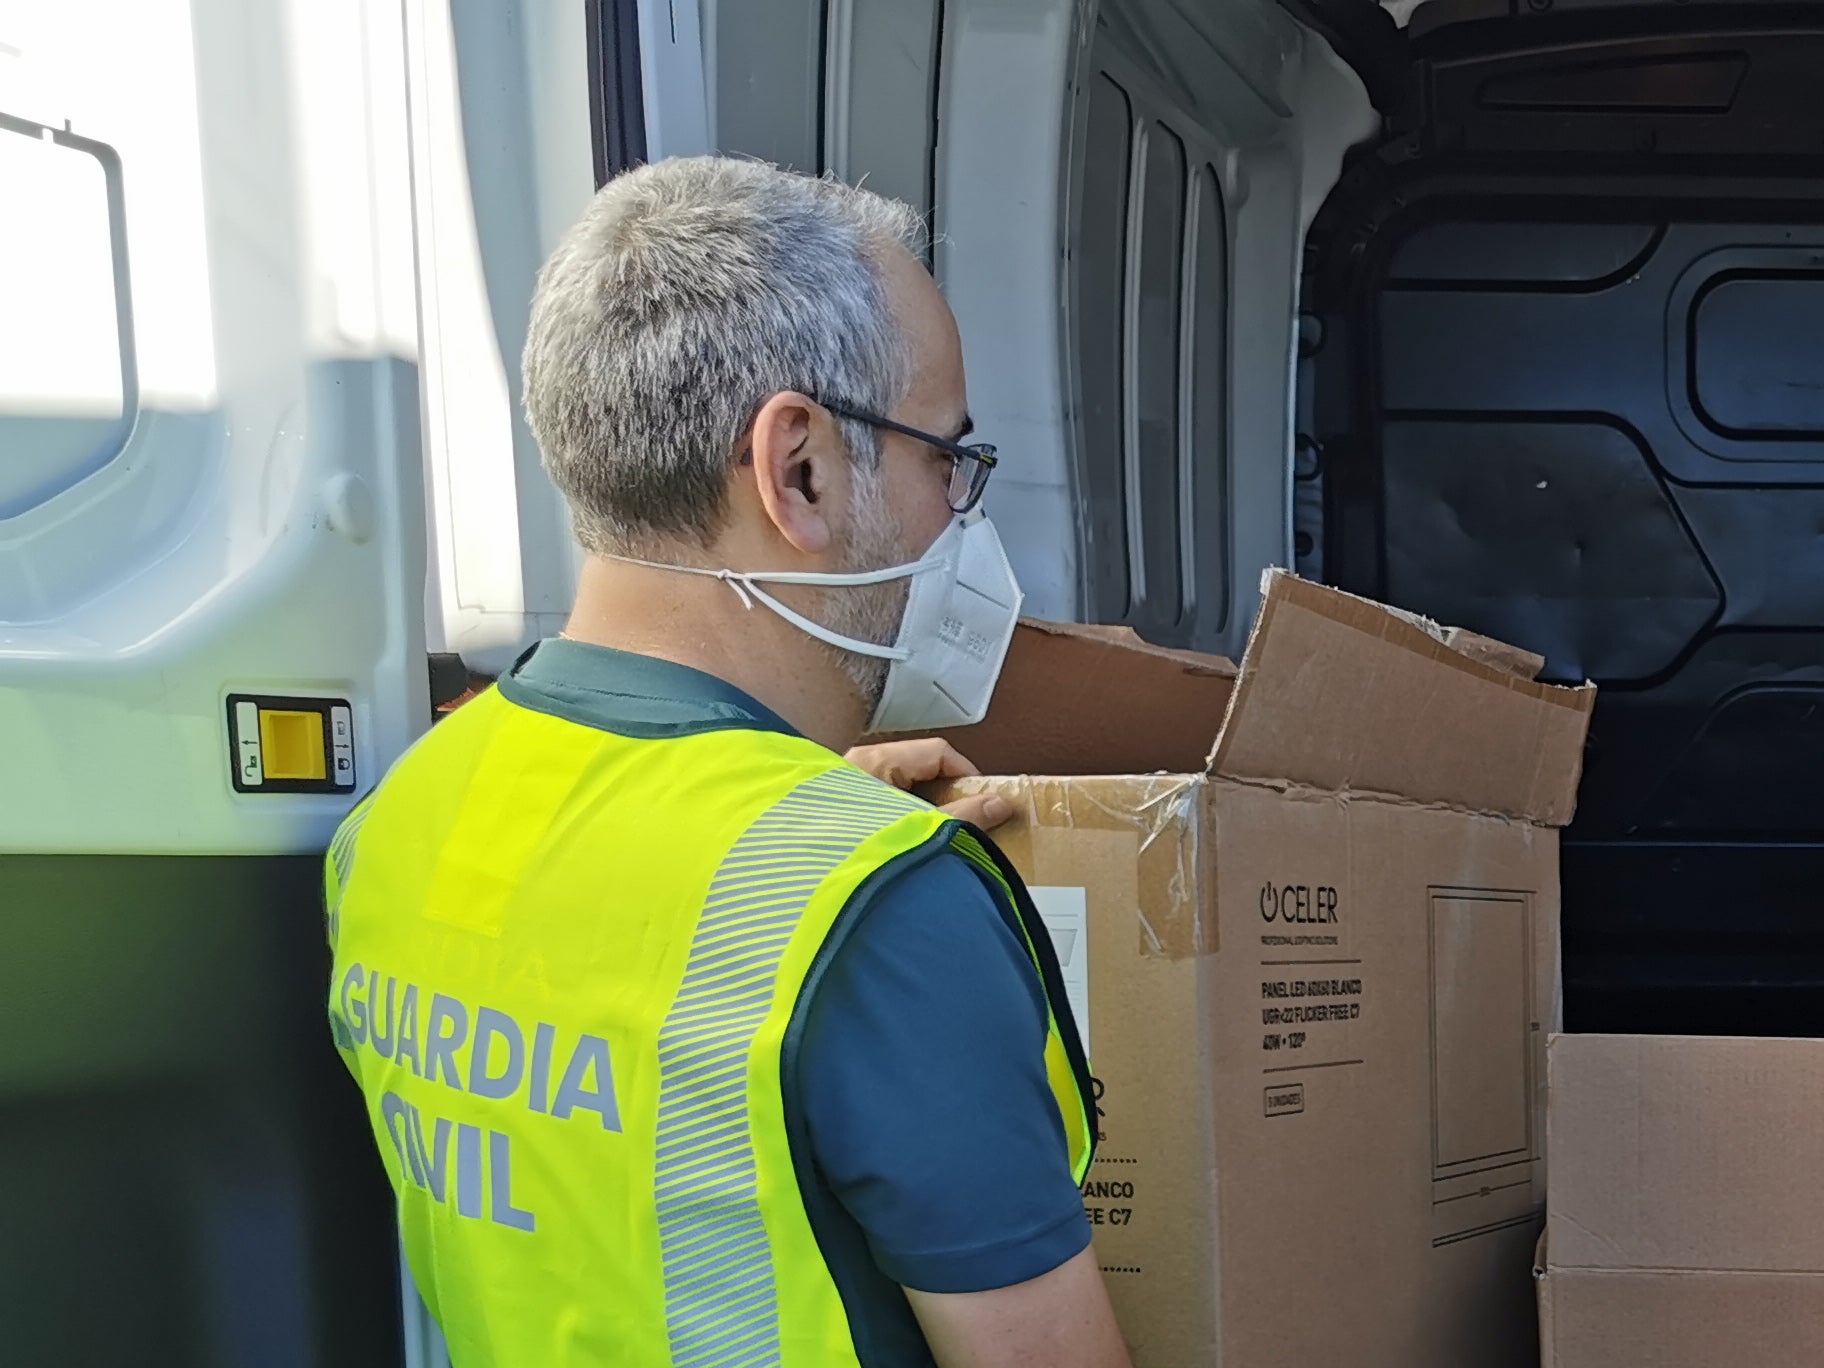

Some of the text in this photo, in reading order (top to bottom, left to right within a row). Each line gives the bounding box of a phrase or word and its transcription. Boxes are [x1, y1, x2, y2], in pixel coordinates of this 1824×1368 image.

[1281, 885, 1339, 924] CELER
[1262, 981, 1289, 998] PANEL
[1290, 980, 1306, 997] LED
[341, 962, 622, 1133] GUARDIA
[381, 1090, 534, 1232] CIVIL
[1082, 1181, 1135, 1199] ANCO
[1109, 1208, 1133, 1226] C7
